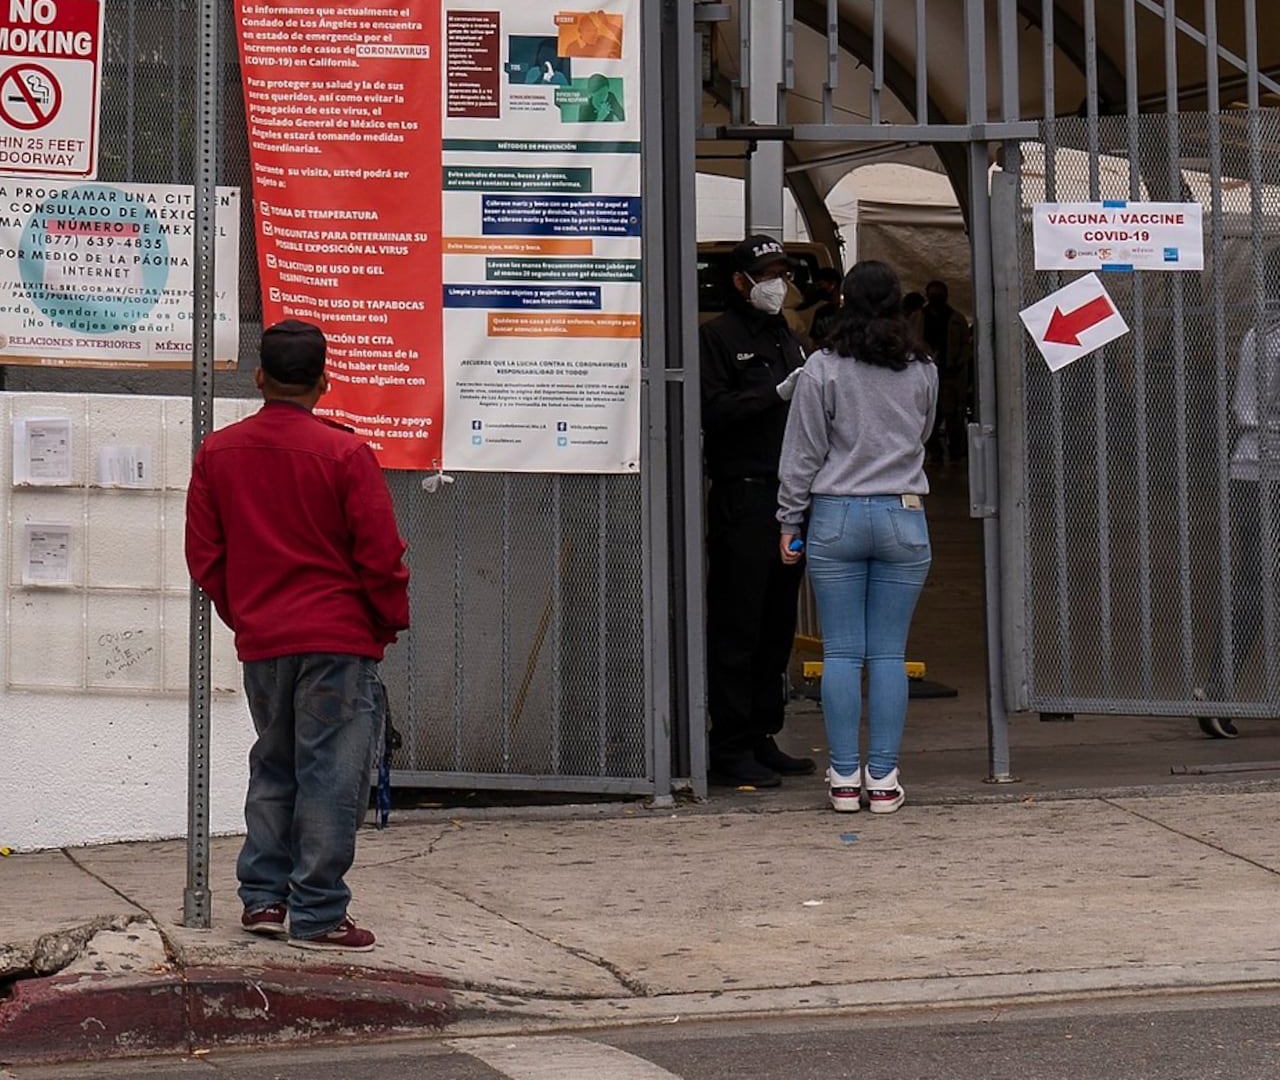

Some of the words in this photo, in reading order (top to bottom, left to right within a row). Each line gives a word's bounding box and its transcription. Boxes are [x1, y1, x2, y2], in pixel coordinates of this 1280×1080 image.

[242, 5, 253, 13] Le
[316, 8, 335, 16] que
[337, 7, 398, 16] actualmente
[400, 8, 409, 17] el
[242, 18, 284, 27] Condado
[286, 19, 298, 27] de
[300, 19, 317, 28] Los
[319, 19, 357, 30] Ángeles
[300, 45, 312, 53] de
[314, 46, 342, 54] casos
[344, 46, 356, 54] de
[358, 46, 428, 56] CORONAVIRUS
[309, 58, 359, 67] California.
[28, 138, 43, 150] 25
[49, 139, 85, 152] FEET
[0, 151, 74, 166] DOORWAY
[16, 187, 116, 202] PROGRAMAR
[125, 192, 156, 203] UNA
[10, 203, 110, 217] CONSULADO
[120, 207, 138, 218] DE
[270, 207, 292, 216] TOMA
[295, 209, 305, 217] DE
[308, 210, 378, 219] TEMPERATURA
[1048, 214, 1108, 224] VACUNA
[1121, 214, 1184, 224] VACCINE
[1084, 231, 1149, 241] COVID-19
[87, 236, 162, 249] 639-4835
[64, 266, 130, 278] INTERNET
